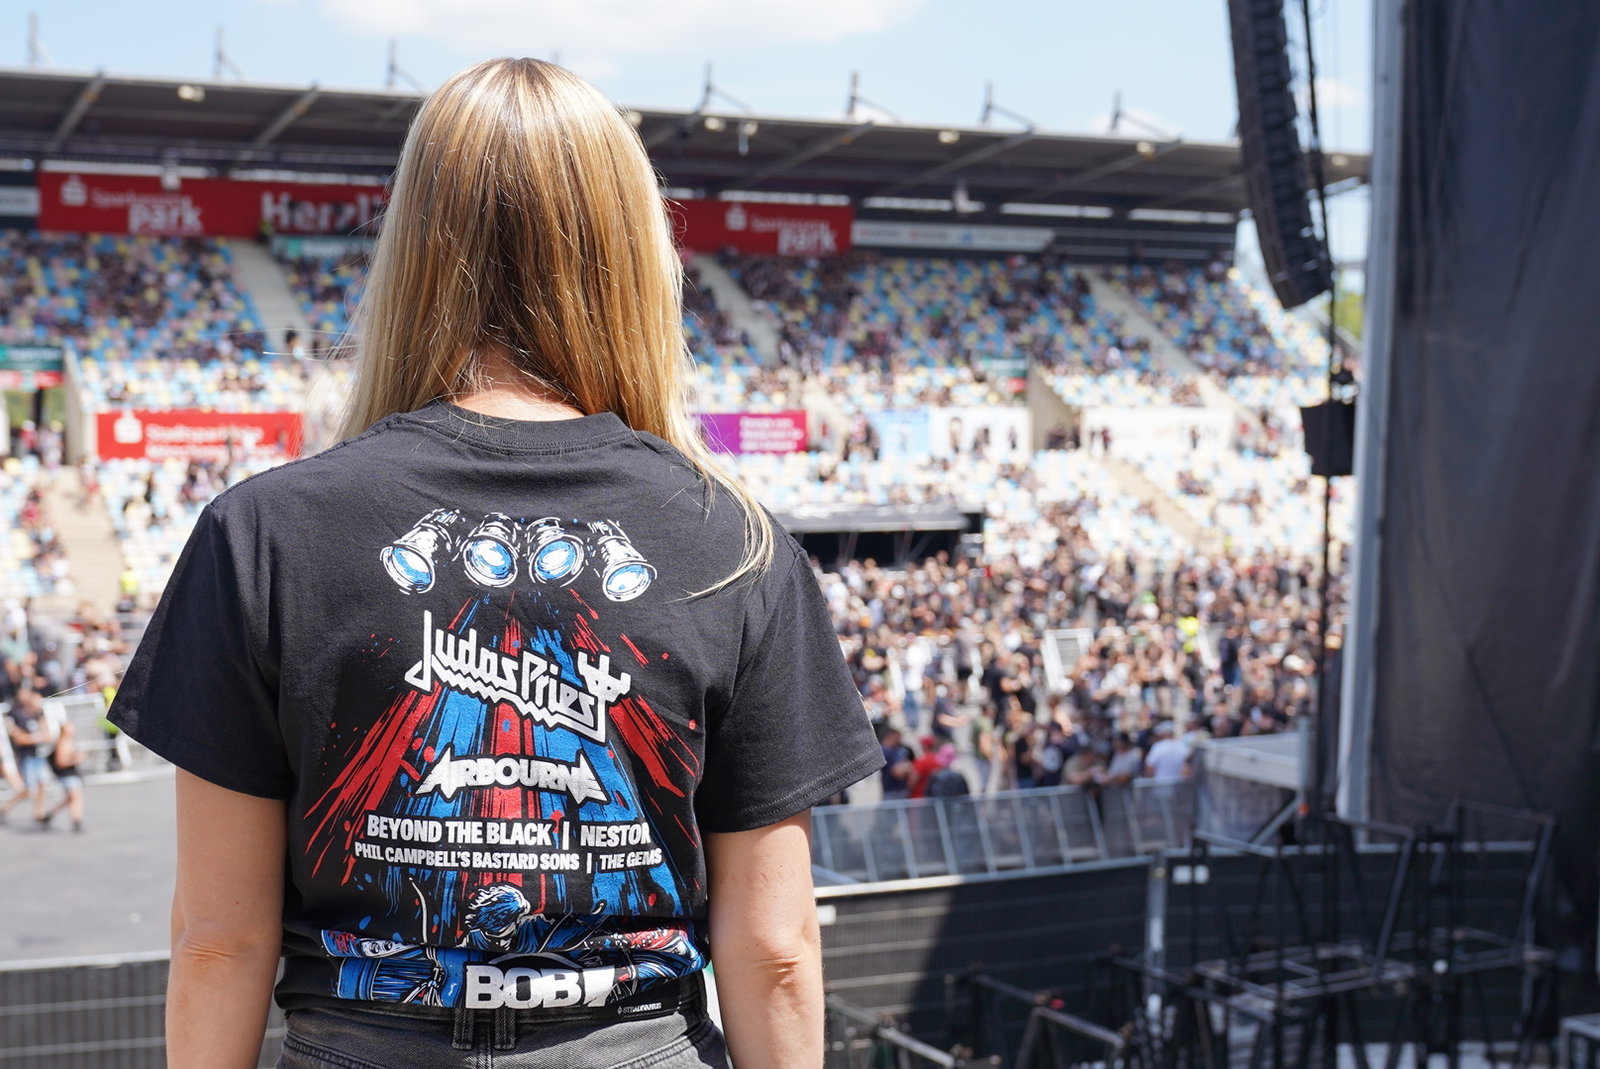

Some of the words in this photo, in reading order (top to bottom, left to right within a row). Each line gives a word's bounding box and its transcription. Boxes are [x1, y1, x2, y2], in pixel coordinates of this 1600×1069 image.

[404, 610, 519, 694] Judas
[521, 650, 631, 743] Priest
[366, 814, 443, 843] BEYOND
[445, 821, 484, 844] THE
[486, 822, 553, 846] BLACK
[354, 841, 384, 861] PHIL
[385, 847, 471, 868] CAMPBELL'S
[472, 851, 539, 870] BASTARD
[540, 853, 580, 870] SONS
[599, 854, 625, 870] THE
[626, 848, 662, 868] GEMS
